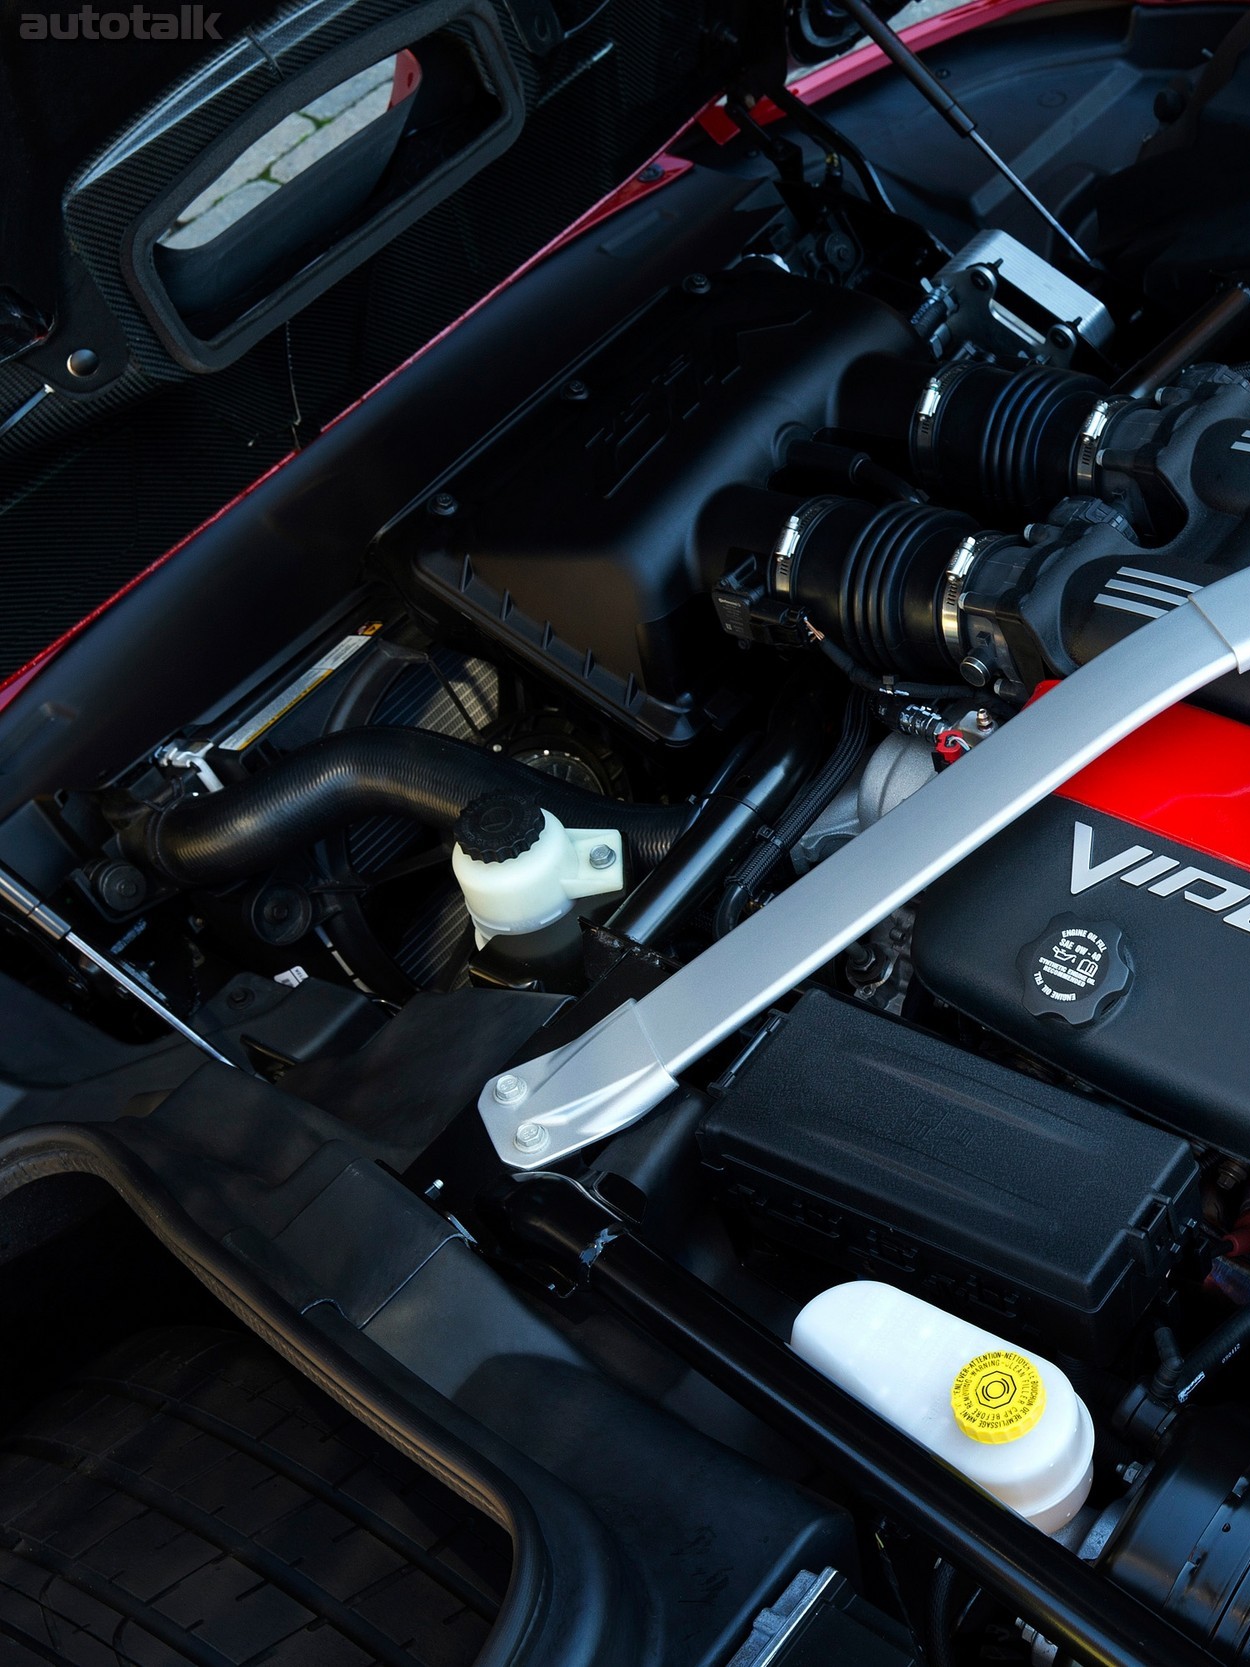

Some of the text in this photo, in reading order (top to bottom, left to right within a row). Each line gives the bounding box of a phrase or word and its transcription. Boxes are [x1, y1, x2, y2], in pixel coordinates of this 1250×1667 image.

[1059, 938, 1075, 950] SAE
[1061, 928, 1107, 953] ENGINE OIL FILL
[1033, 971, 1076, 1001] ENGINE OIL FILL
